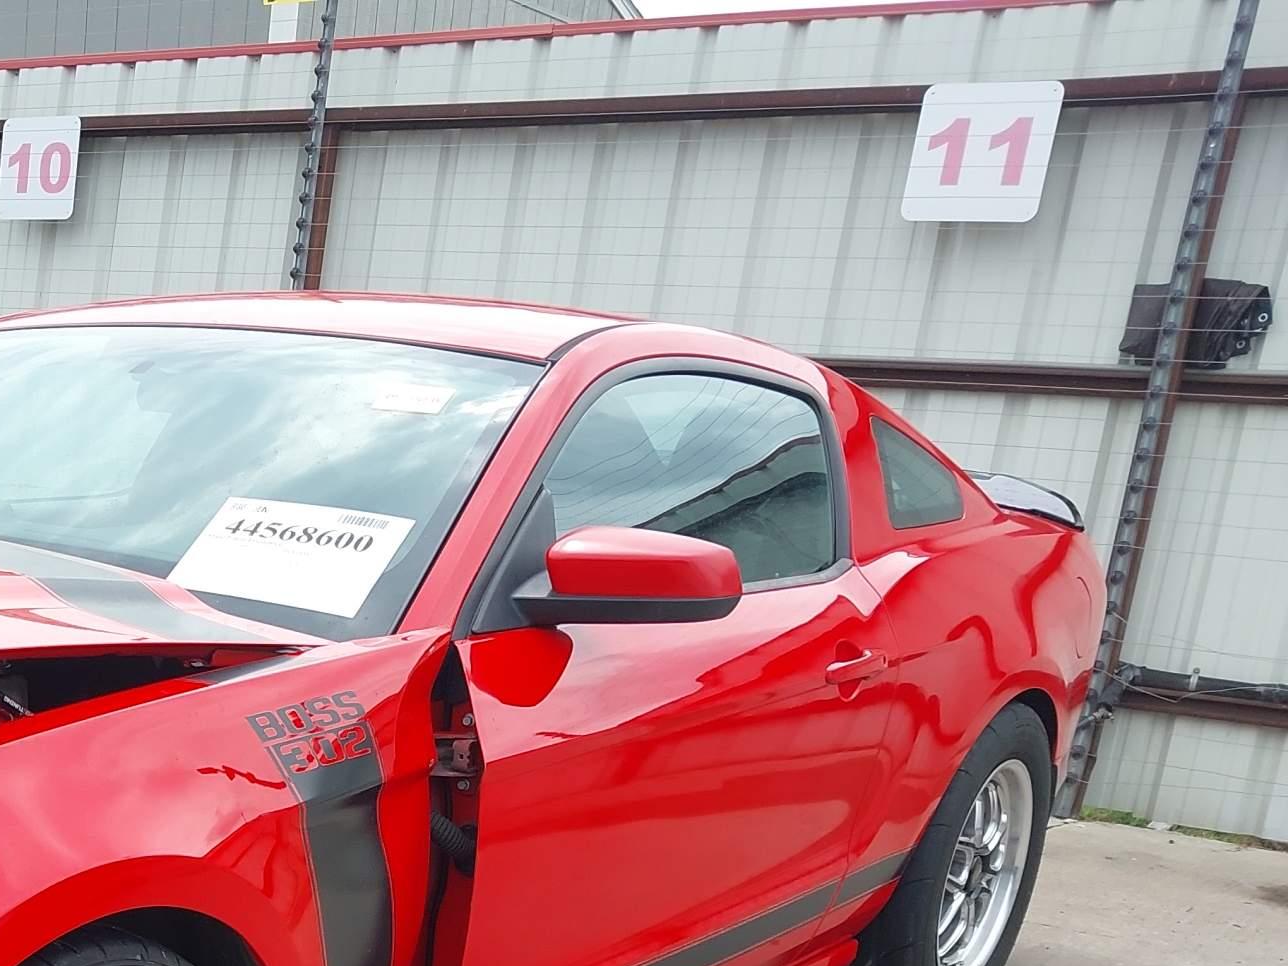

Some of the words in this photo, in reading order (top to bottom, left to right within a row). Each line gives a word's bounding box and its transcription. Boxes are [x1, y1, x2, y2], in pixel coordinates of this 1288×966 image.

[8, 142, 71, 193] 10
[928, 117, 1034, 185] 11
[225, 519, 374, 552] 44568600
[247, 691, 365, 742] BOSS
[279, 725, 372, 774] 302
